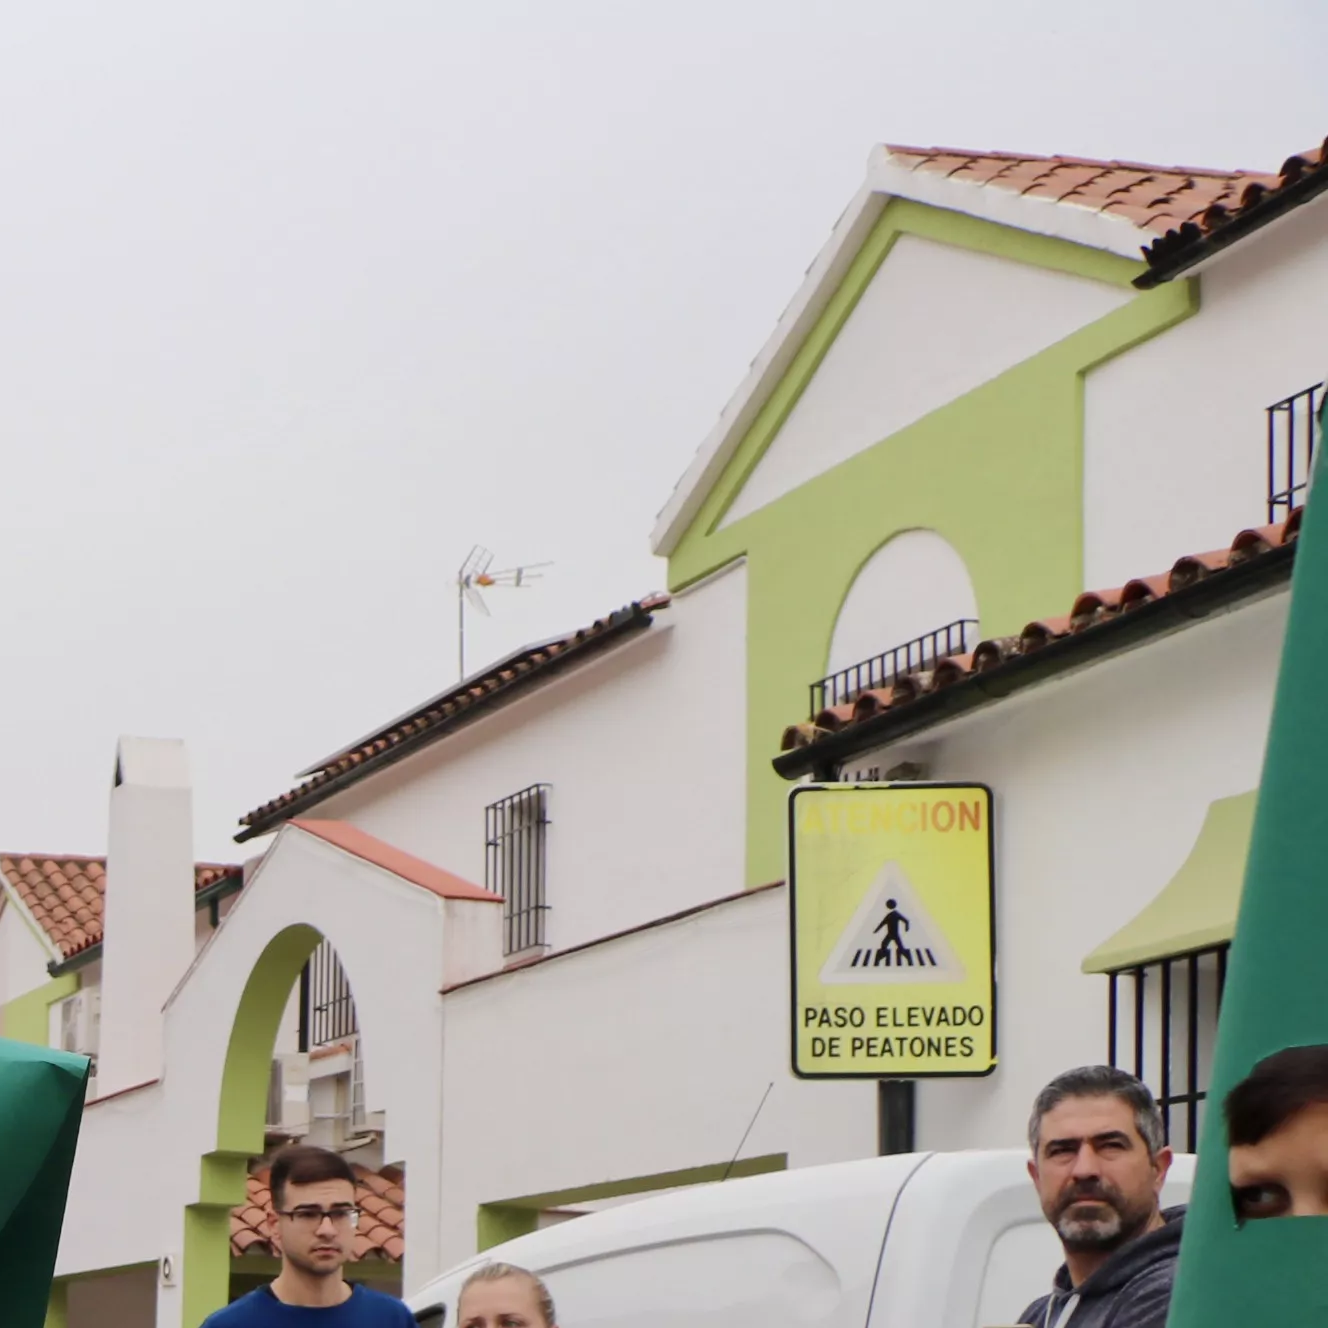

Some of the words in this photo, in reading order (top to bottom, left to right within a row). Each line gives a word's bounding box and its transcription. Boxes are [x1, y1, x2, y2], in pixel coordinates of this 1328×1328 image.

[802, 800, 981, 834] ATENCION
[804, 1006, 865, 1028] PASO
[876, 1005, 985, 1028] ELEVADO
[811, 1036, 841, 1058] DE
[851, 1036, 975, 1058] PEATONES
